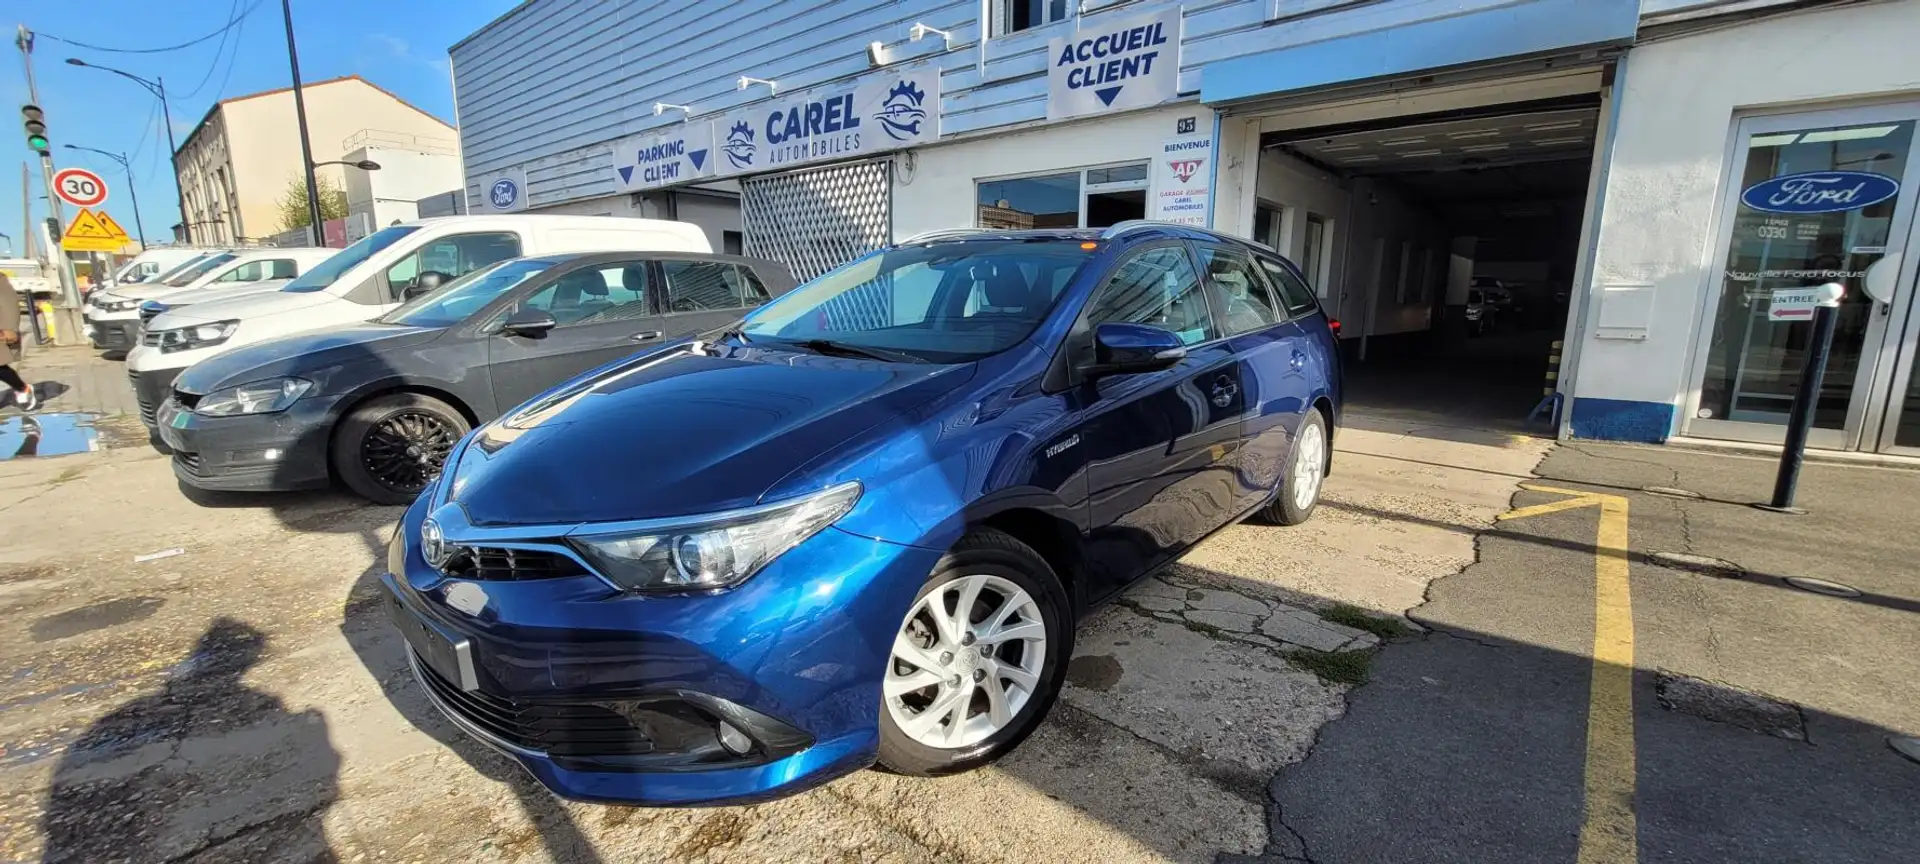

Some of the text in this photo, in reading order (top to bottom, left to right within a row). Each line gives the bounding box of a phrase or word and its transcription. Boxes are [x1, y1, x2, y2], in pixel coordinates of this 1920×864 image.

[1057, 22, 1167, 67] ACCUEIL
[1067, 51, 1159, 90] CLIENT
[766, 93, 861, 145] CAREL
[638, 139, 684, 164] PARKING
[770, 133, 861, 164] AUTOMOBILES
[1164, 140, 1210, 152] BIENVENUE
[644, 161, 681, 182] CLIENT
[1175, 162, 1198, 177] AD
[66, 180, 96, 196] 30
[494, 183, 513, 205] Ford
[1769, 177, 1866, 206] Ford
[1724, 269, 1866, 279] Nouvelle Ford focus
[1772, 295, 1814, 304] ENTREE
